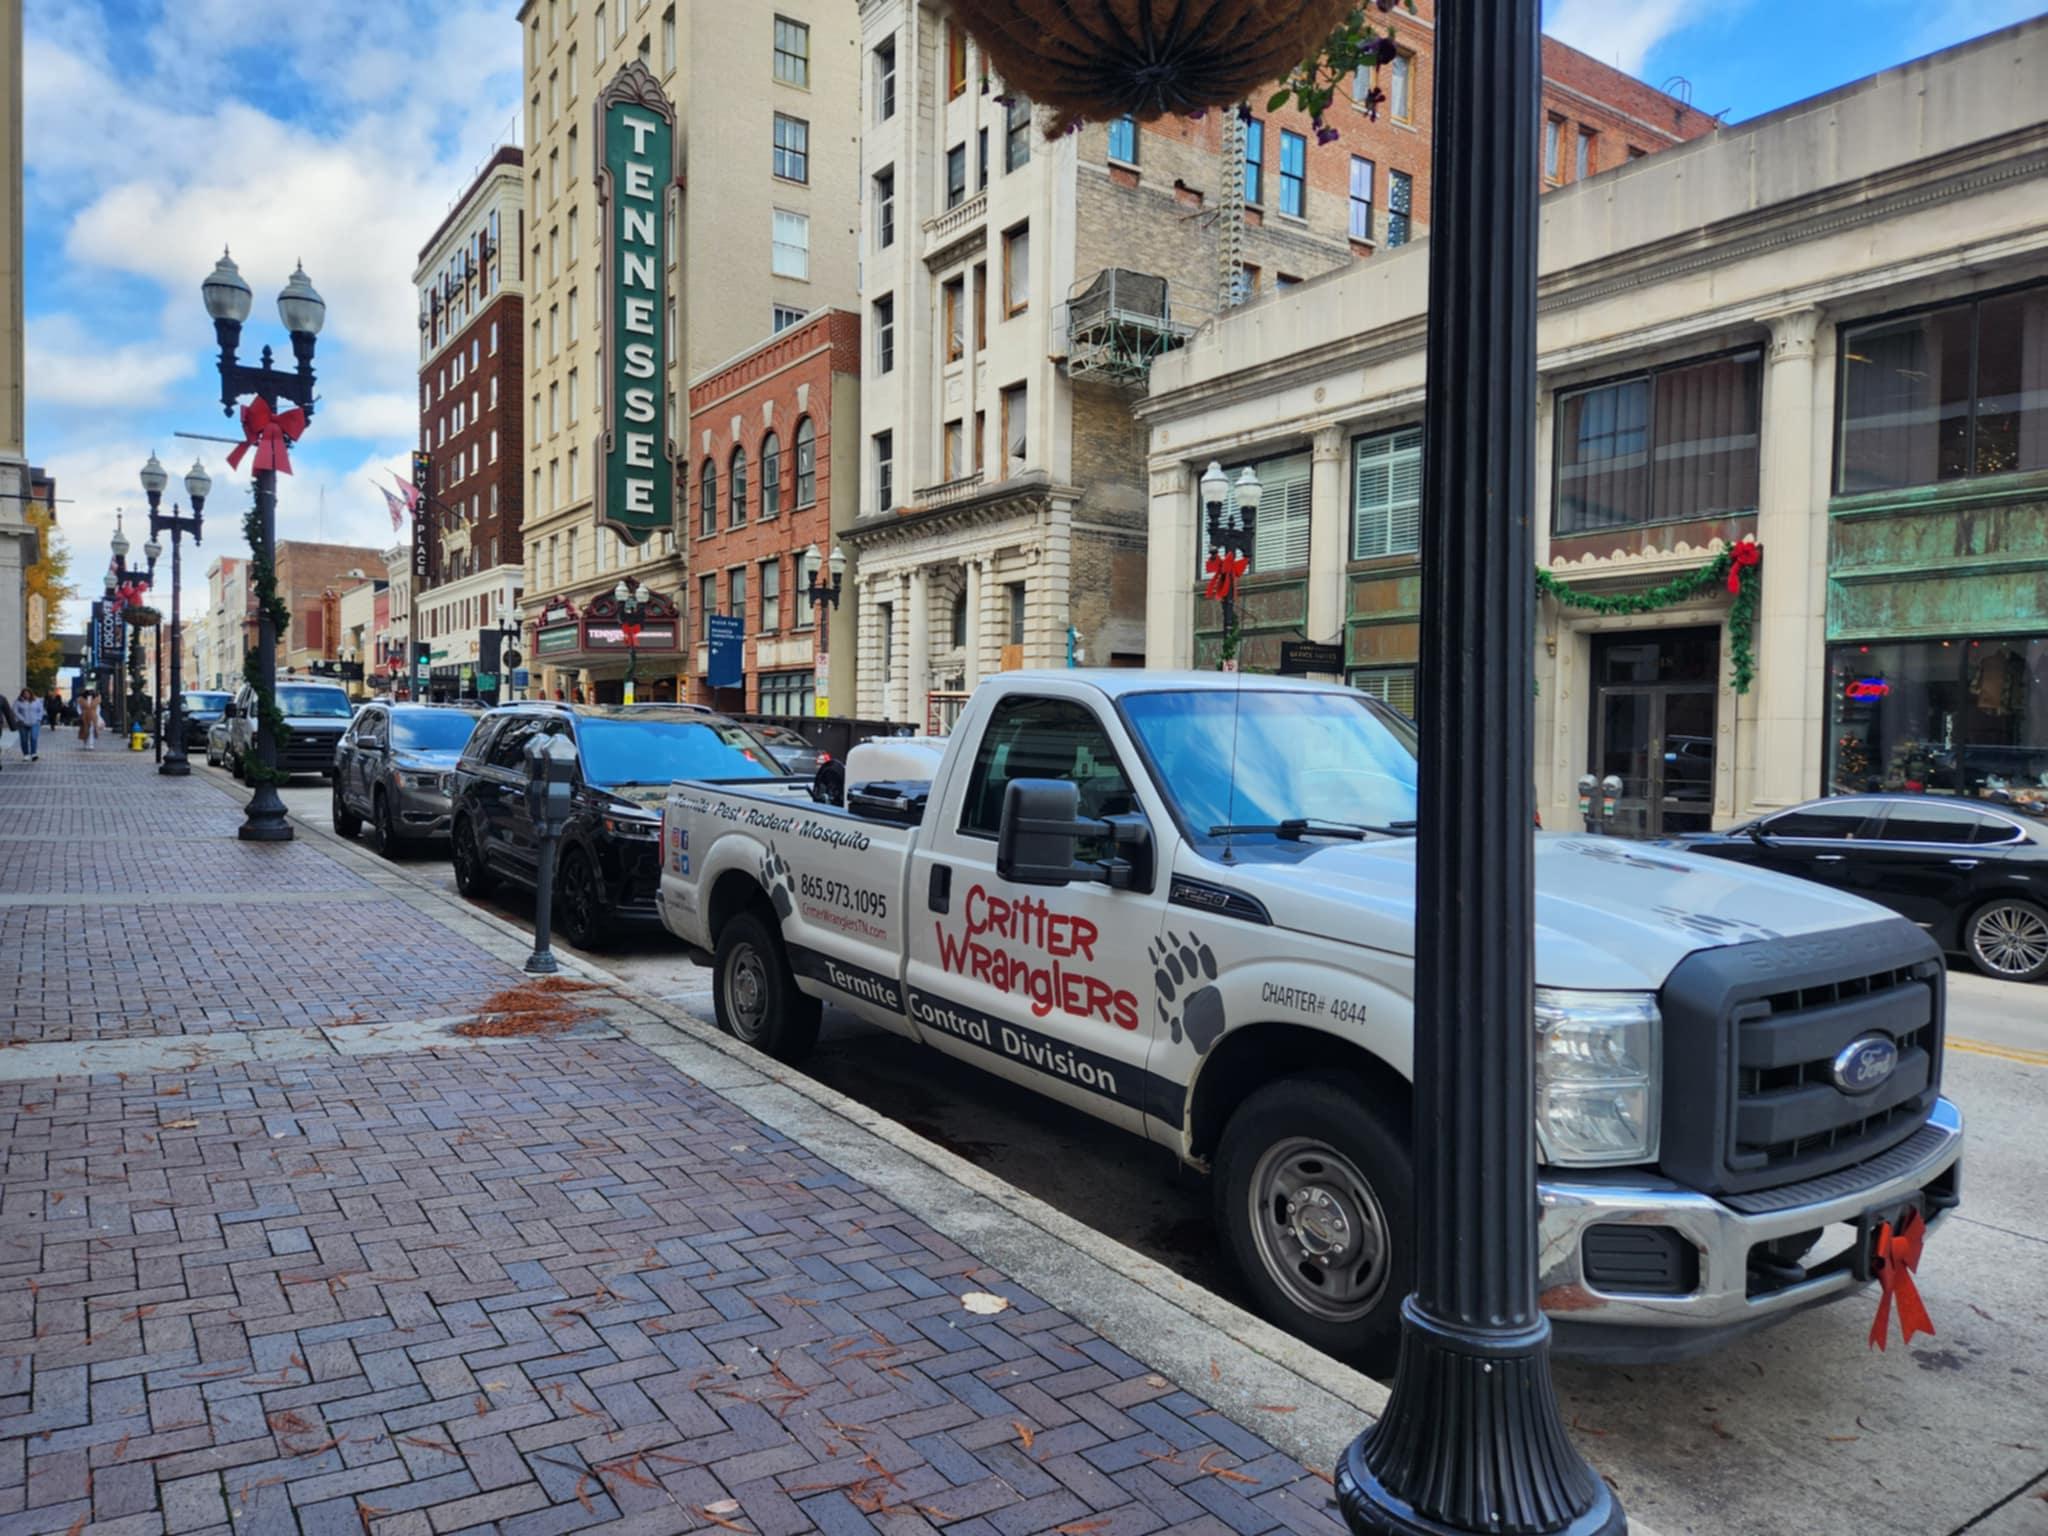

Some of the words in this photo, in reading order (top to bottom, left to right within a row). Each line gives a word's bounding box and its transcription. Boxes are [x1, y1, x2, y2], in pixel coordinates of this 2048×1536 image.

[623, 114, 656, 514] TENNESSEE
[416, 524, 426, 575] PLACE
[714, 802, 741, 821] Pest
[745, 809, 794, 833] Rodent
[799, 820, 871, 851] Mosquito
[801, 873, 887, 919] 865.973.1095
[824, 961, 898, 1008] Termite
[908, 993, 991, 1045] Control
[1001, 1027, 1117, 1093] Division
[1330, 999, 1366, 1025] 4844
[1857, 1049, 1891, 1080] Ford
